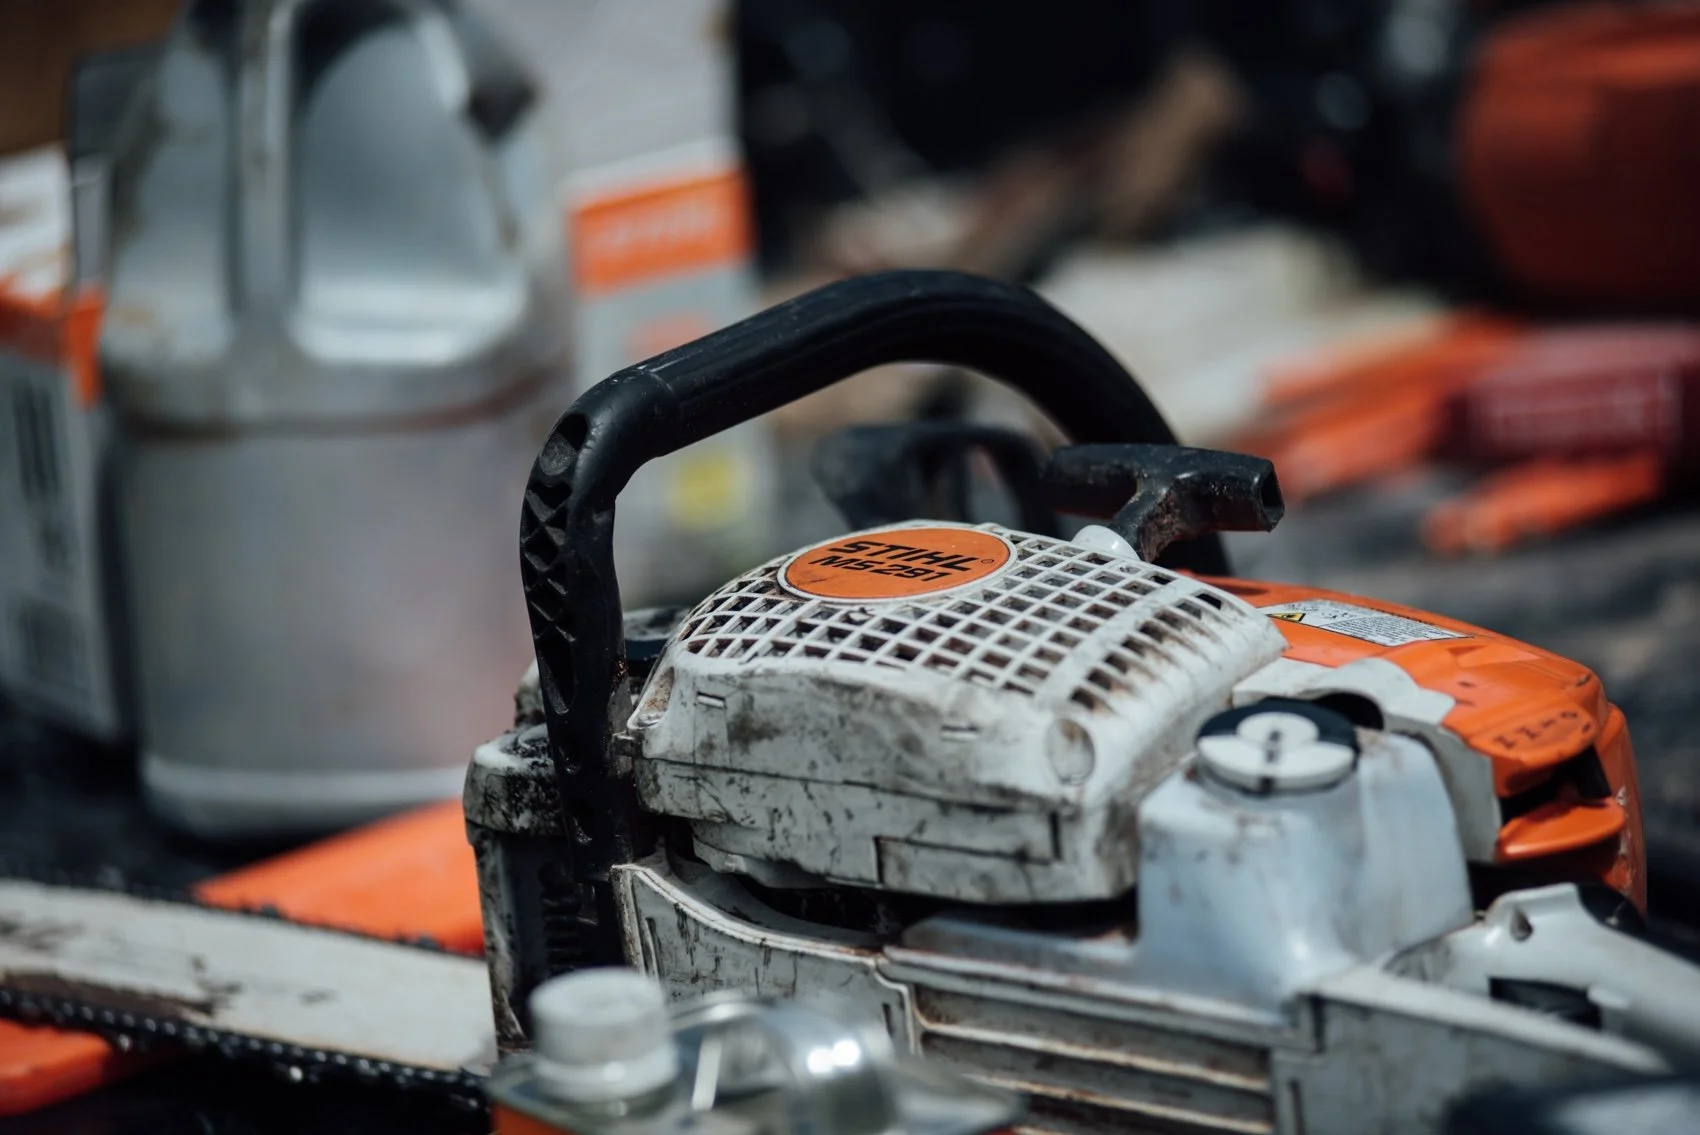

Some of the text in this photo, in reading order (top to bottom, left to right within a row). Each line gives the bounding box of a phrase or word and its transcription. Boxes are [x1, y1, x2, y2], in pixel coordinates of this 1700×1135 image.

[808, 555, 953, 582] MS 291
[827, 540, 979, 572] STIHL
